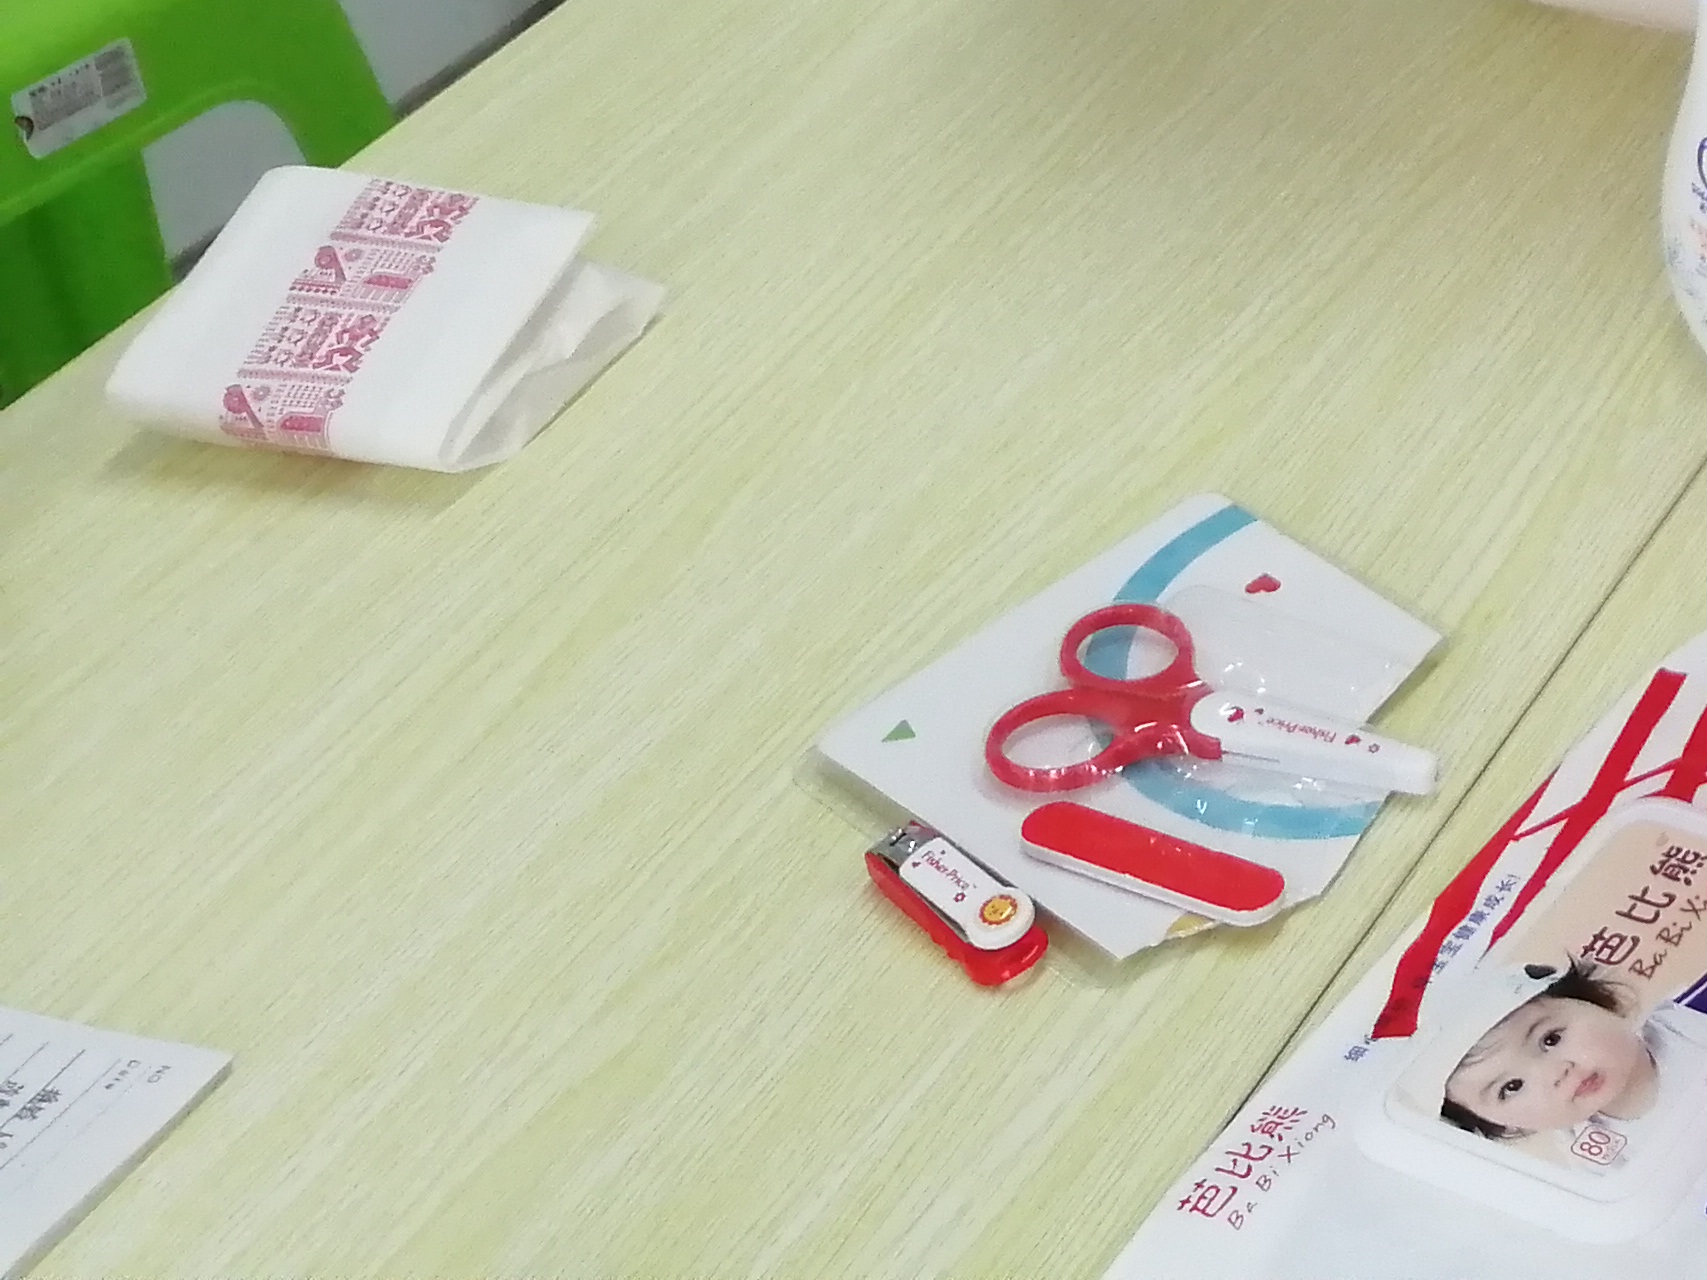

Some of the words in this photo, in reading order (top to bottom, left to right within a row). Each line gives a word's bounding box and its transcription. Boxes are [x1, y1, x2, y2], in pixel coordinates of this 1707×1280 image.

[1628, 951, 1669, 981] Ba
[1655, 920, 1693, 948] Bi
[1176, 1105, 1308, 1217] 芭比熊
[1227, 1201, 1258, 1230] Ba
[1255, 1165, 1280, 1192] Bi
[1277, 1113, 1337, 1164] Xiong
[1580, 1131, 1610, 1156] 80
